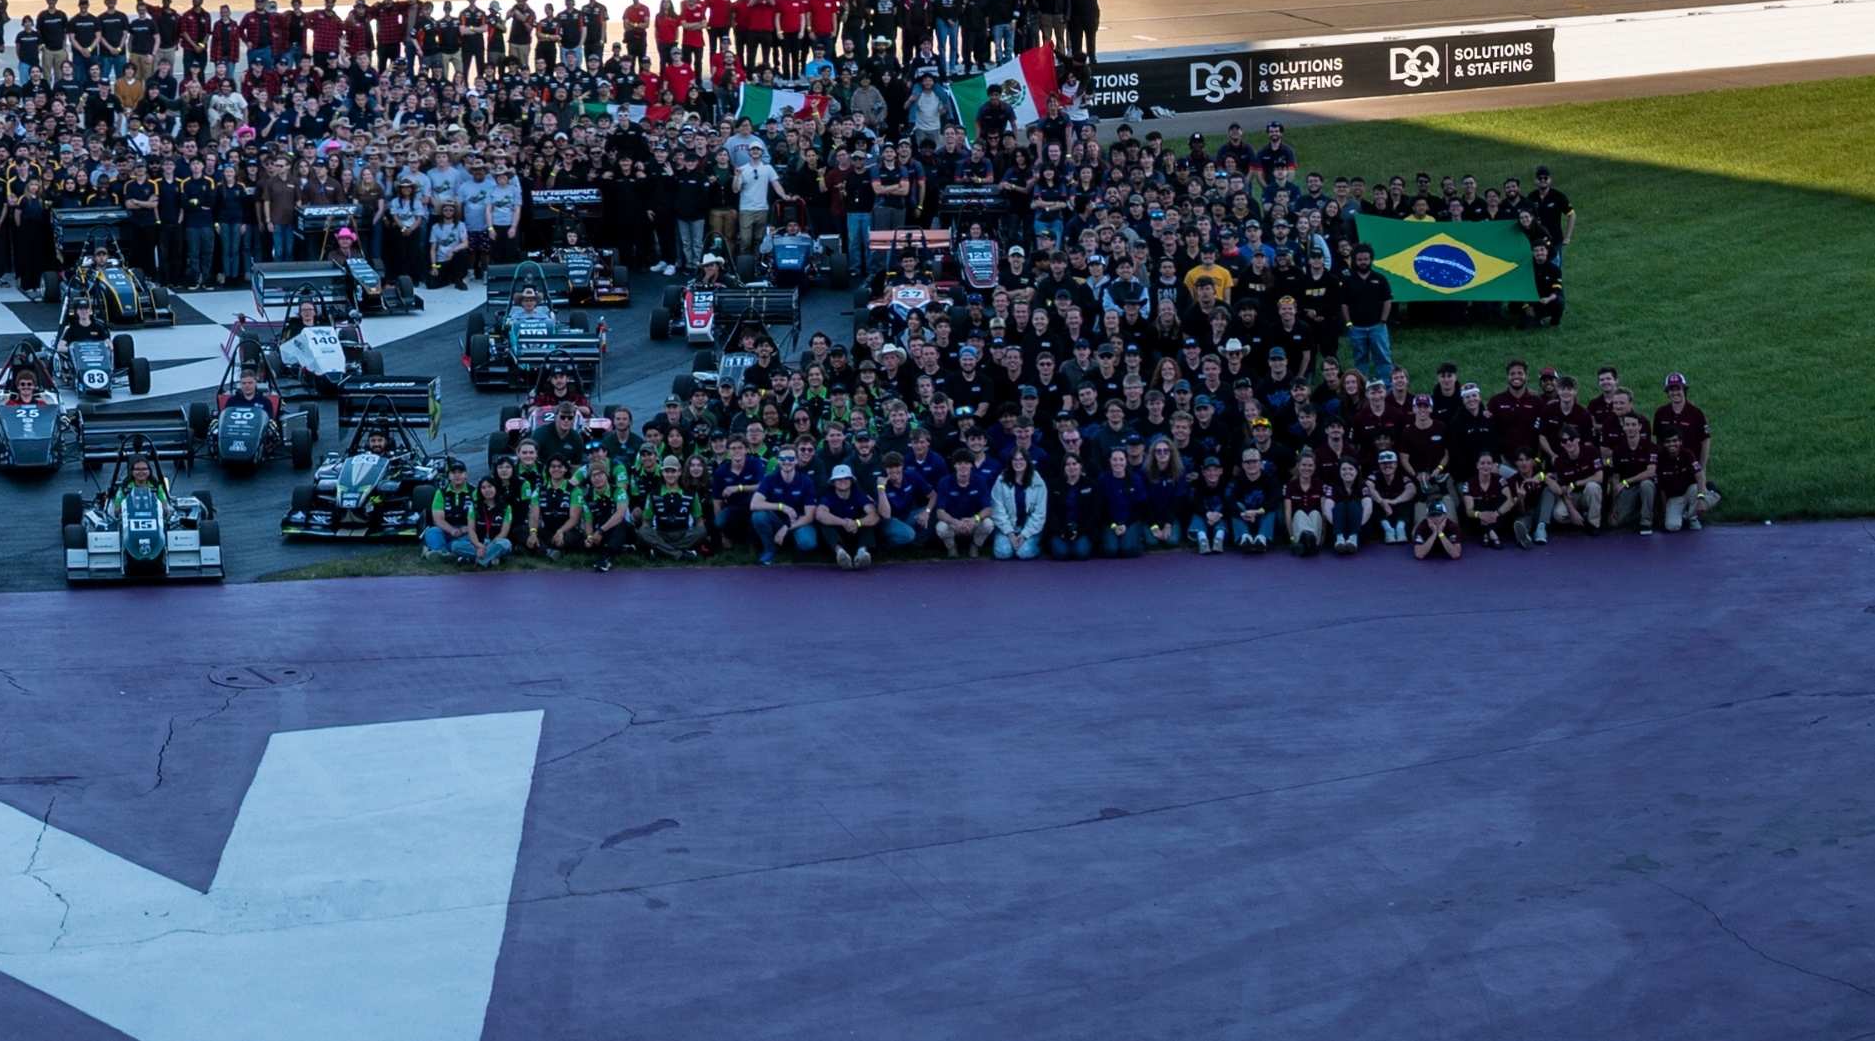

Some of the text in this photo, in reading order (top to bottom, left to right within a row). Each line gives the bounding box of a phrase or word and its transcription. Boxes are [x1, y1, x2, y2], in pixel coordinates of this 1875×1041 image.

[1454, 42, 1533, 61] SOLUTIONS
[1258, 57, 1343, 76] SOLUTIONS
[1454, 59, 1533, 77] & STAFFING
[1258, 74, 1344, 93] & STAFFING
[694, 294, 714, 302] 134
[311, 336, 337, 346] 140
[87, 373, 104, 384] 83
[16, 409, 40, 418] 25
[231, 411, 254, 420] 30
[133, 520, 153, 530] 15
